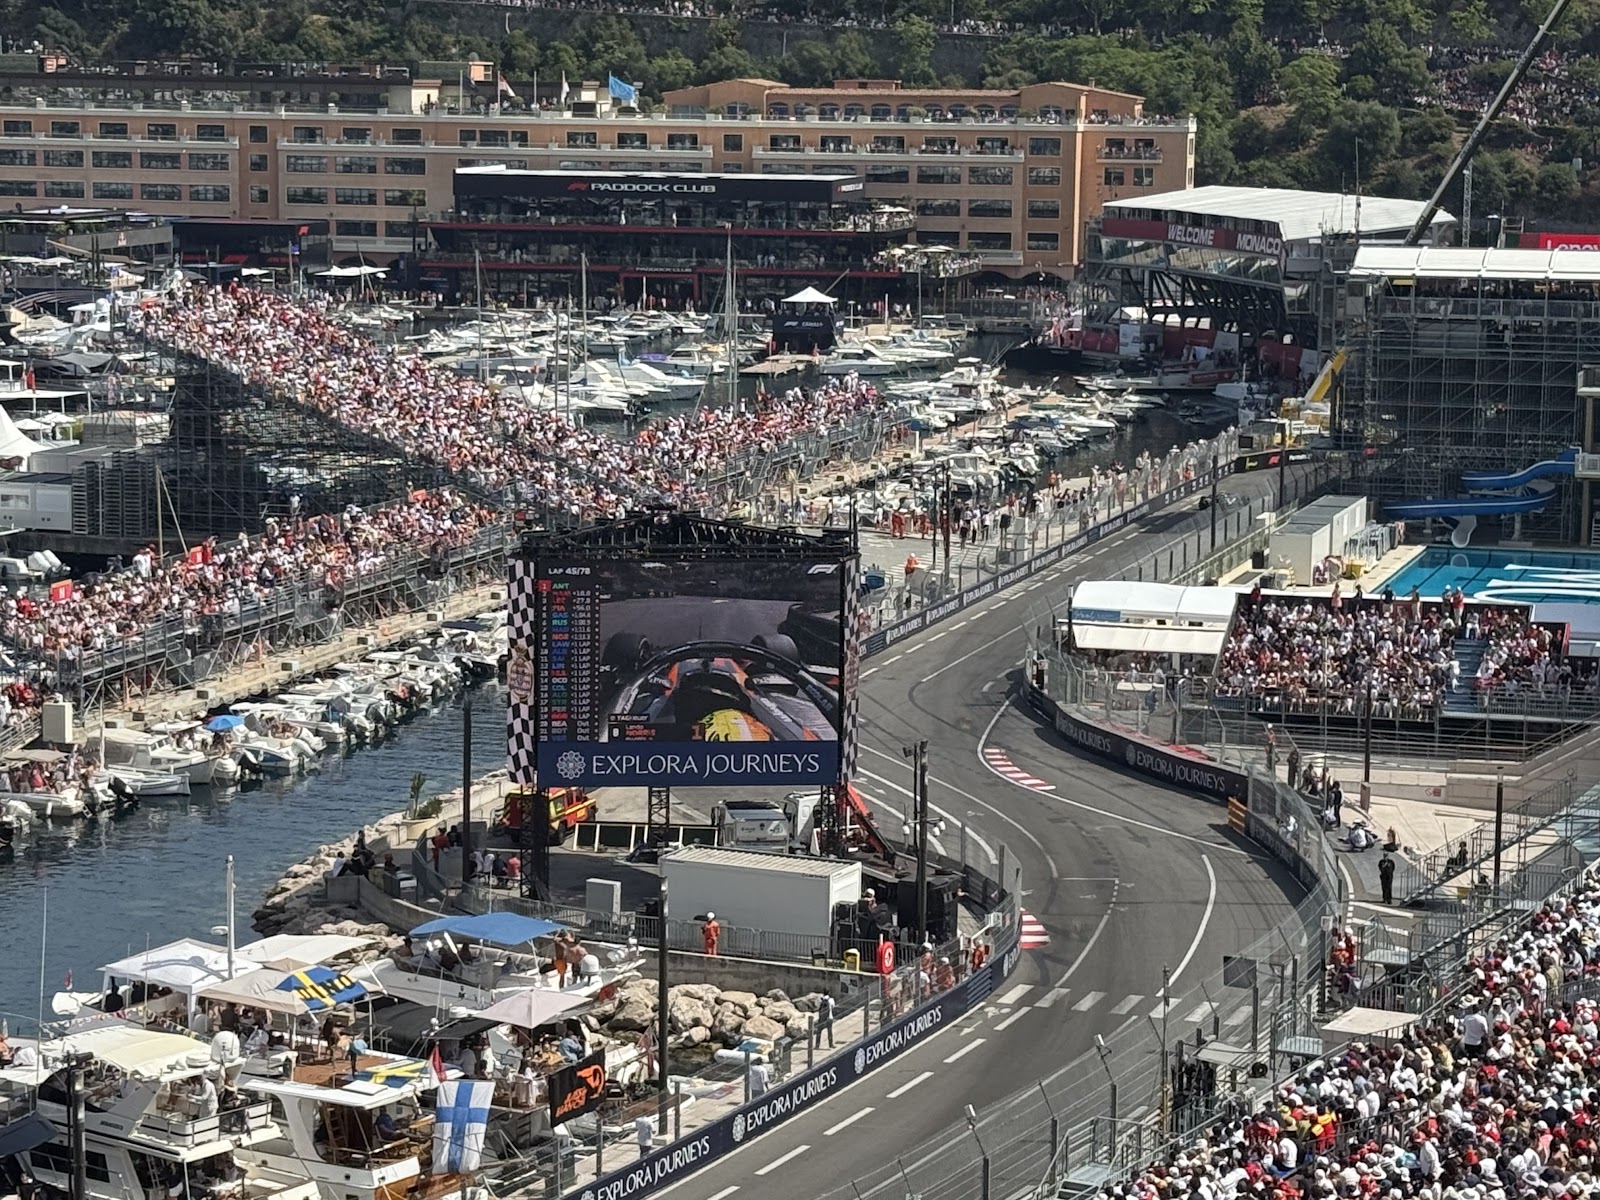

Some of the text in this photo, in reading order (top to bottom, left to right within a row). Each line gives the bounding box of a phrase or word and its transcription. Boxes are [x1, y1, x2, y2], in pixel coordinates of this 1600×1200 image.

[591, 183, 670, 192] PADDOCK
[673, 184, 716, 193] CLUB
[1168, 224, 1215, 246] WELCOME
[1236, 233, 1282, 254] MONACO
[612, 728, 619, 737] 8
[1078, 730, 1111, 753] JOURNEYS
[592, 753, 820, 778] EXPLORA JOURNEYS
[1136, 751, 1226, 792] EXPLORA JOURNEYS
[293, 974, 356, 1000] DINO
[866, 1005, 942, 1064] EXPLORA JOURNEYS
[747, 1066, 837, 1132] EXPLORA JOURNEYS
[597, 1135, 710, 1200] EXPLORA JOURNEYS
